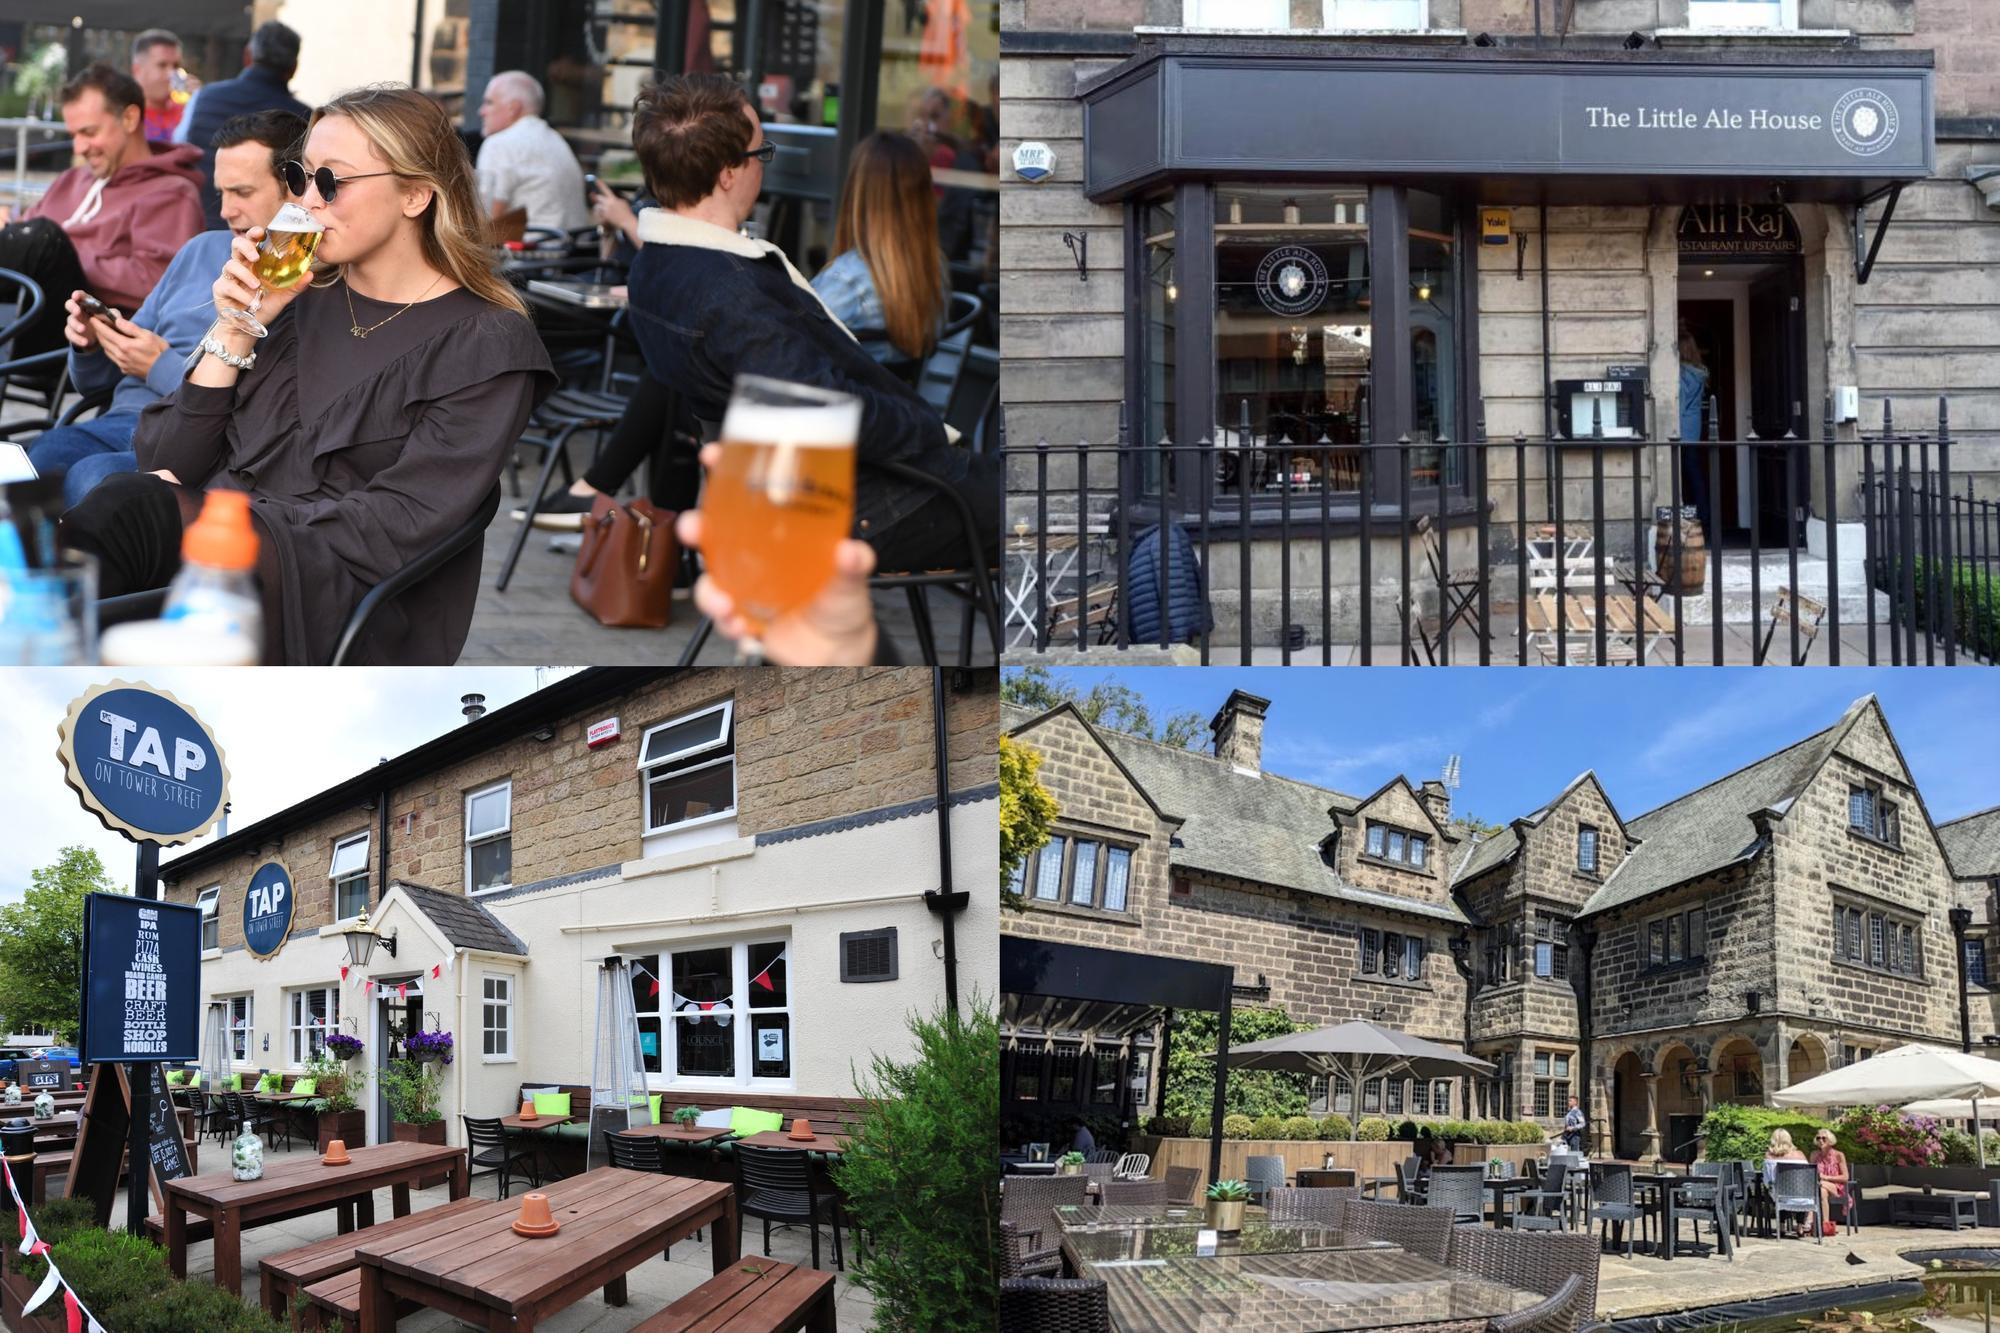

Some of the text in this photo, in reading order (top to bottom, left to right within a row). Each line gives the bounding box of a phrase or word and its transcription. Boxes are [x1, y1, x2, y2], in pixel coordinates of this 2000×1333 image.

[1585, 107, 1823, 130] The Little Ale House
[1486, 216, 1506, 227] Yale
[1679, 202, 1783, 240] Ali Raj
[1680, 241, 1796, 250] ESTAURANT UPSTAIRS
[1264, 248, 1291, 268] LITTLE
[1292, 249, 1309, 259] ALE
[100, 709, 207, 781] TAP
[95, 762, 202, 809] ON TOWER STREET
[249, 881, 285, 919] TAP
[138, 908, 159, 921] GIN
[140, 920, 157, 930] IPA
[255, 918, 268, 933] TOWER
[269, 915, 284, 930] STREET
[138, 930, 159, 941] RUM
[136, 939, 160, 955] PIZZA
[135, 952, 160, 964] CASK
[131, 961, 163, 973] WINES
[124, 970, 167, 981] BOARD GAMES
[125, 978, 167, 1001] BEER
[124, 1000, 167, 1011] CRAFT
[125, 1009, 166, 1021] BEER
[124, 1020, 166, 1030] BOTTLE
[123, 1029, 167, 1040] SHOP
[124, 1041, 168, 1053] NOODLES
[34, 1074, 59, 1085] GIN
